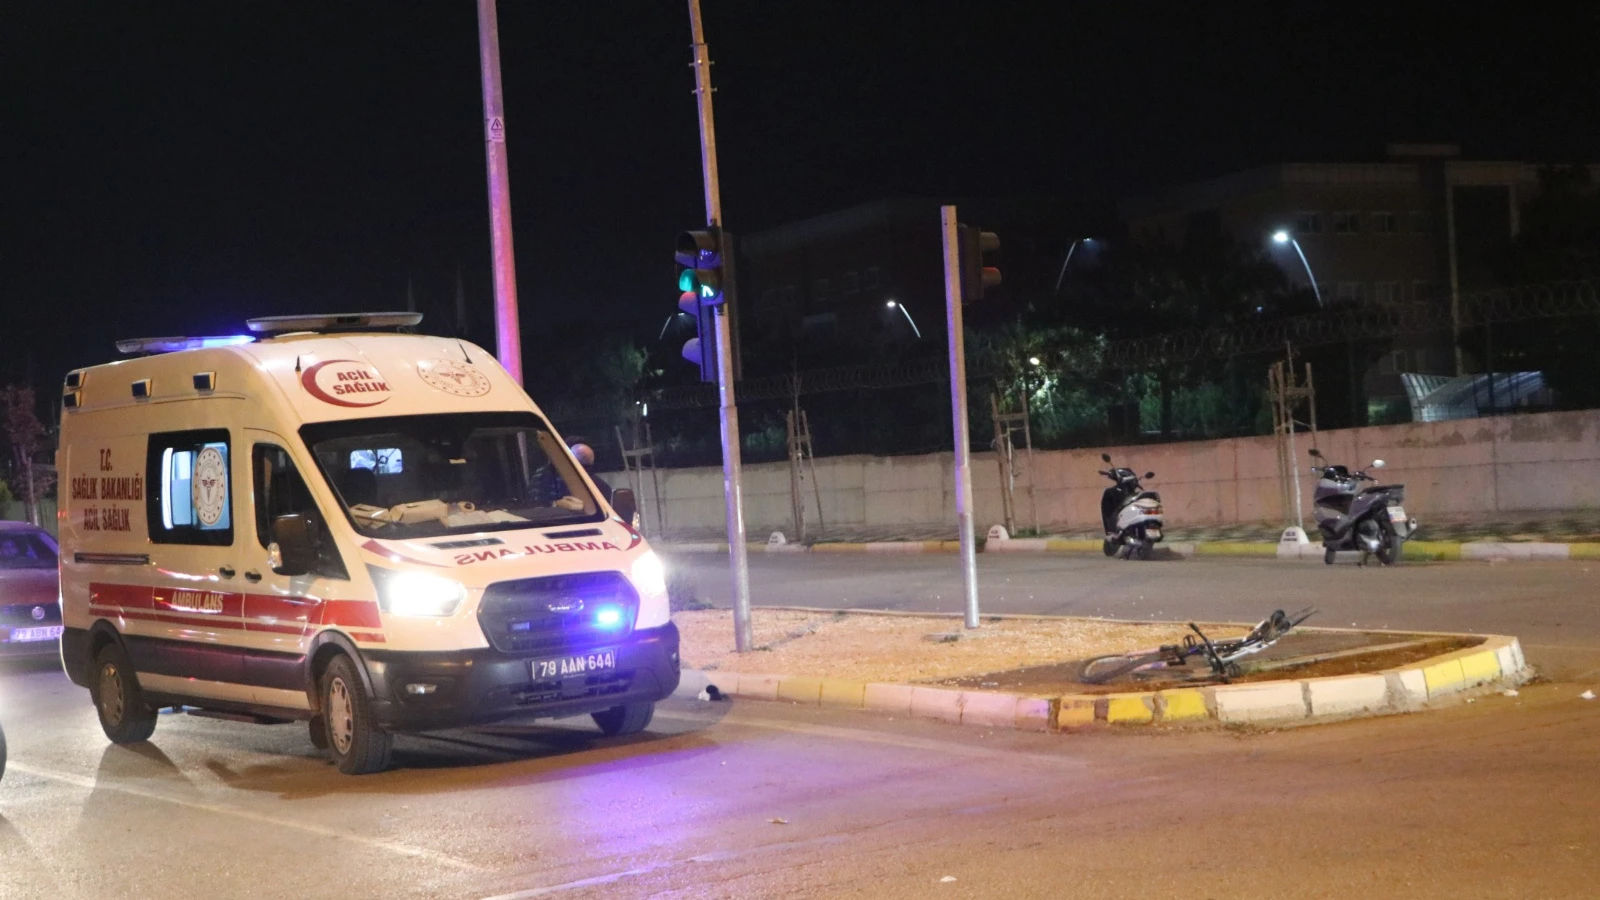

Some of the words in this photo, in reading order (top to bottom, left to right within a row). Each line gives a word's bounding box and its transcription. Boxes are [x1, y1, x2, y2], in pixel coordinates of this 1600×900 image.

[336, 369, 373, 381] ACİL
[332, 381, 391, 395] SAĞLIK
[100, 448, 113, 472] T.C.
[72, 473, 98, 500] SAĞLIK
[101, 472, 143, 501] BAKANLIĞI
[83, 504, 100, 531] ACİL
[102, 503, 131, 532] SAĞLIK
[172, 591, 223, 613] AMBULANS
[540, 660, 557, 677] 79
[561, 656, 585, 674] AAN
[588, 652, 612, 670] 644
